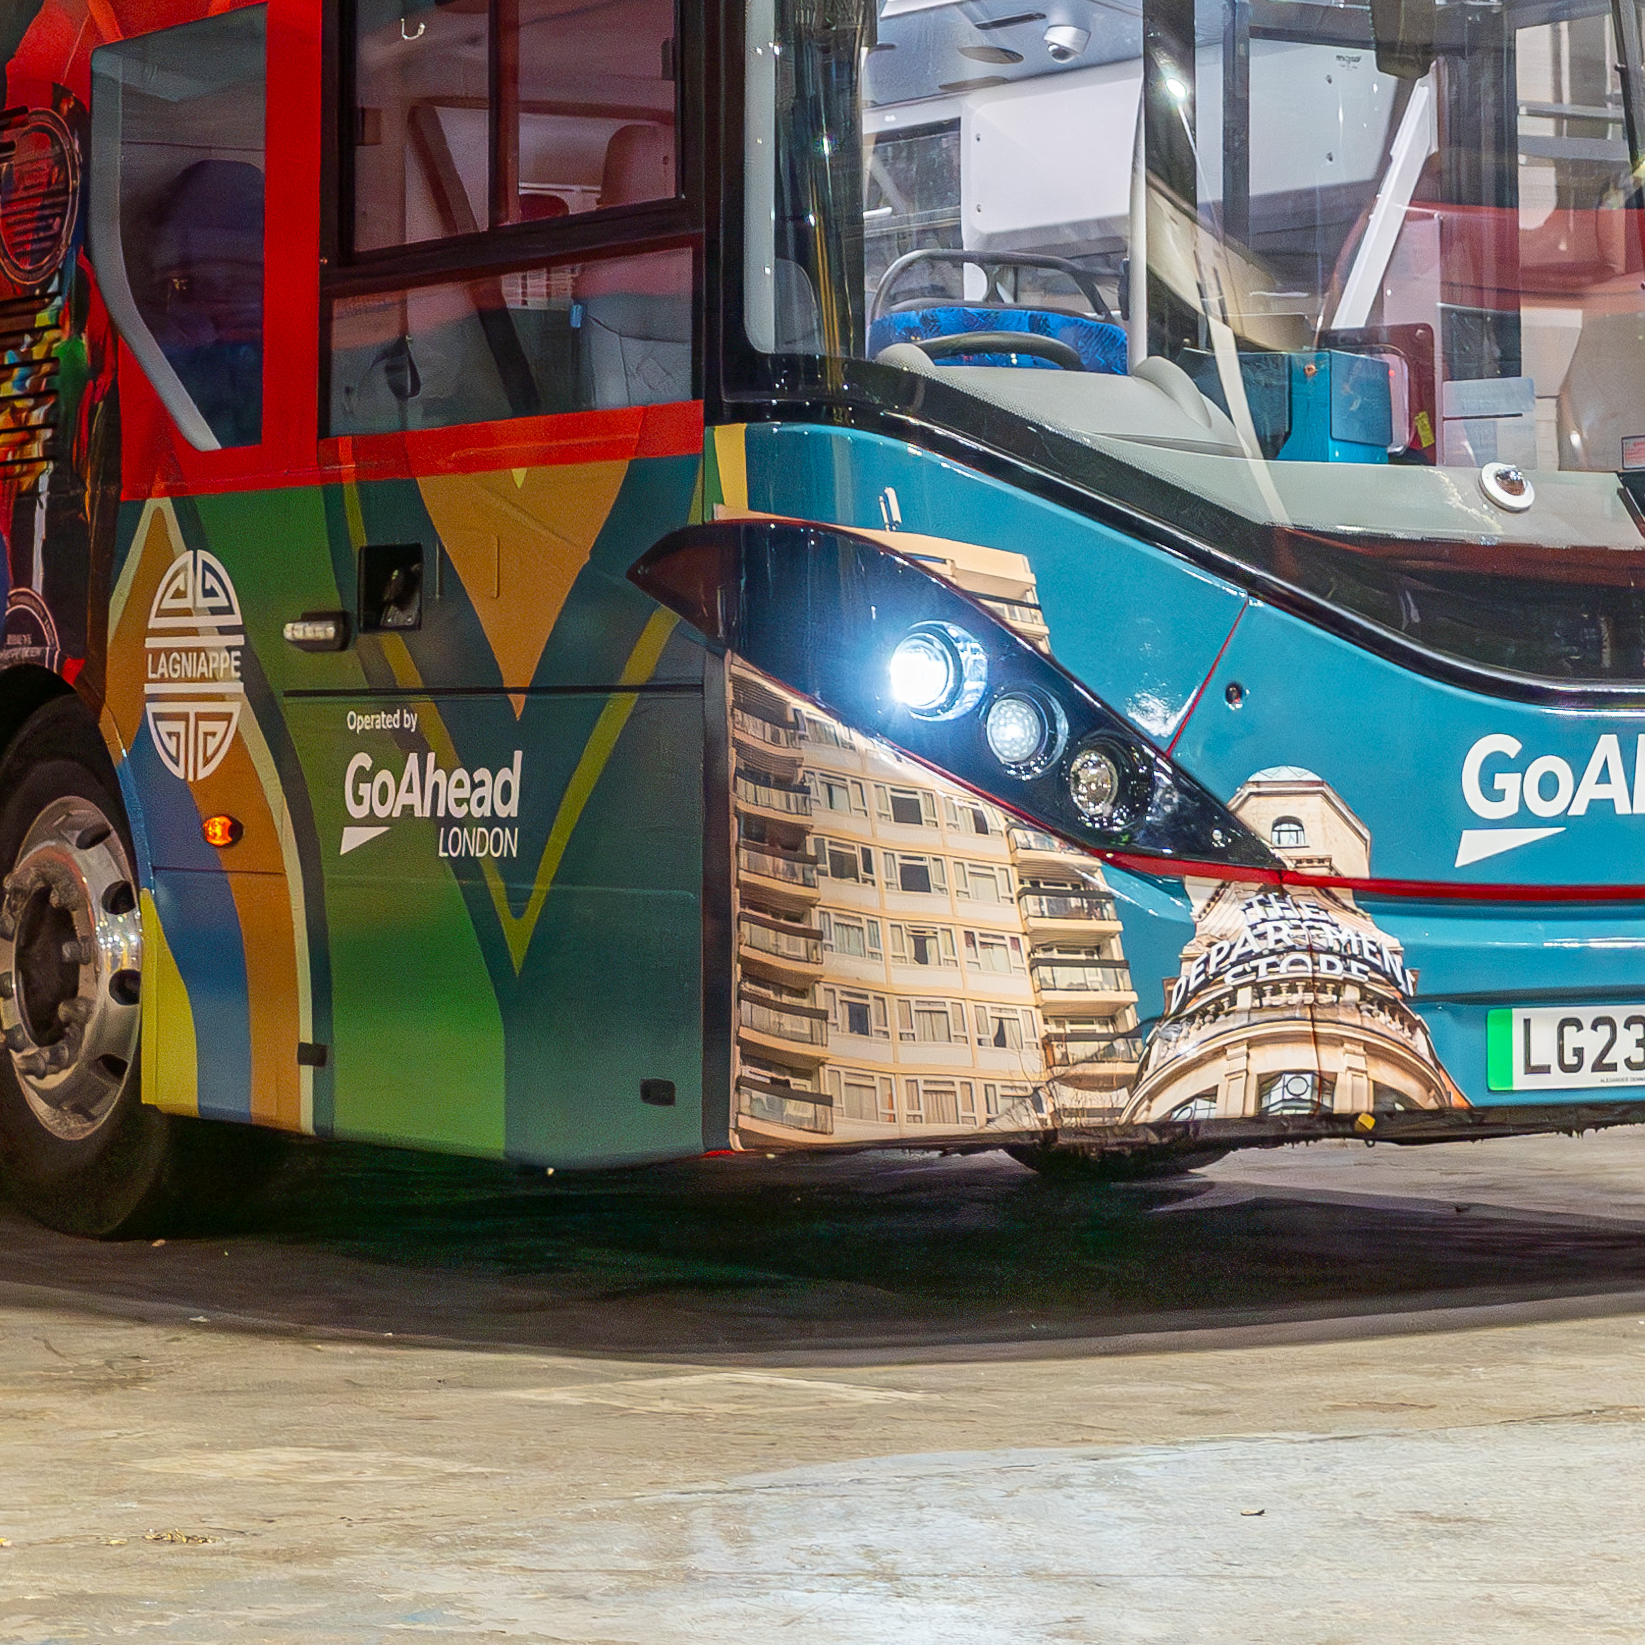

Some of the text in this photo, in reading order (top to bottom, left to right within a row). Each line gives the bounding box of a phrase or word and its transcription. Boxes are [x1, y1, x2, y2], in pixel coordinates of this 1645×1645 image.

[147, 650, 242, 679] LAGNIAPPE
[346, 708, 418, 734] Operated by
[344, 749, 524, 820] GoAhead
[438, 826, 519, 858] LONDON
